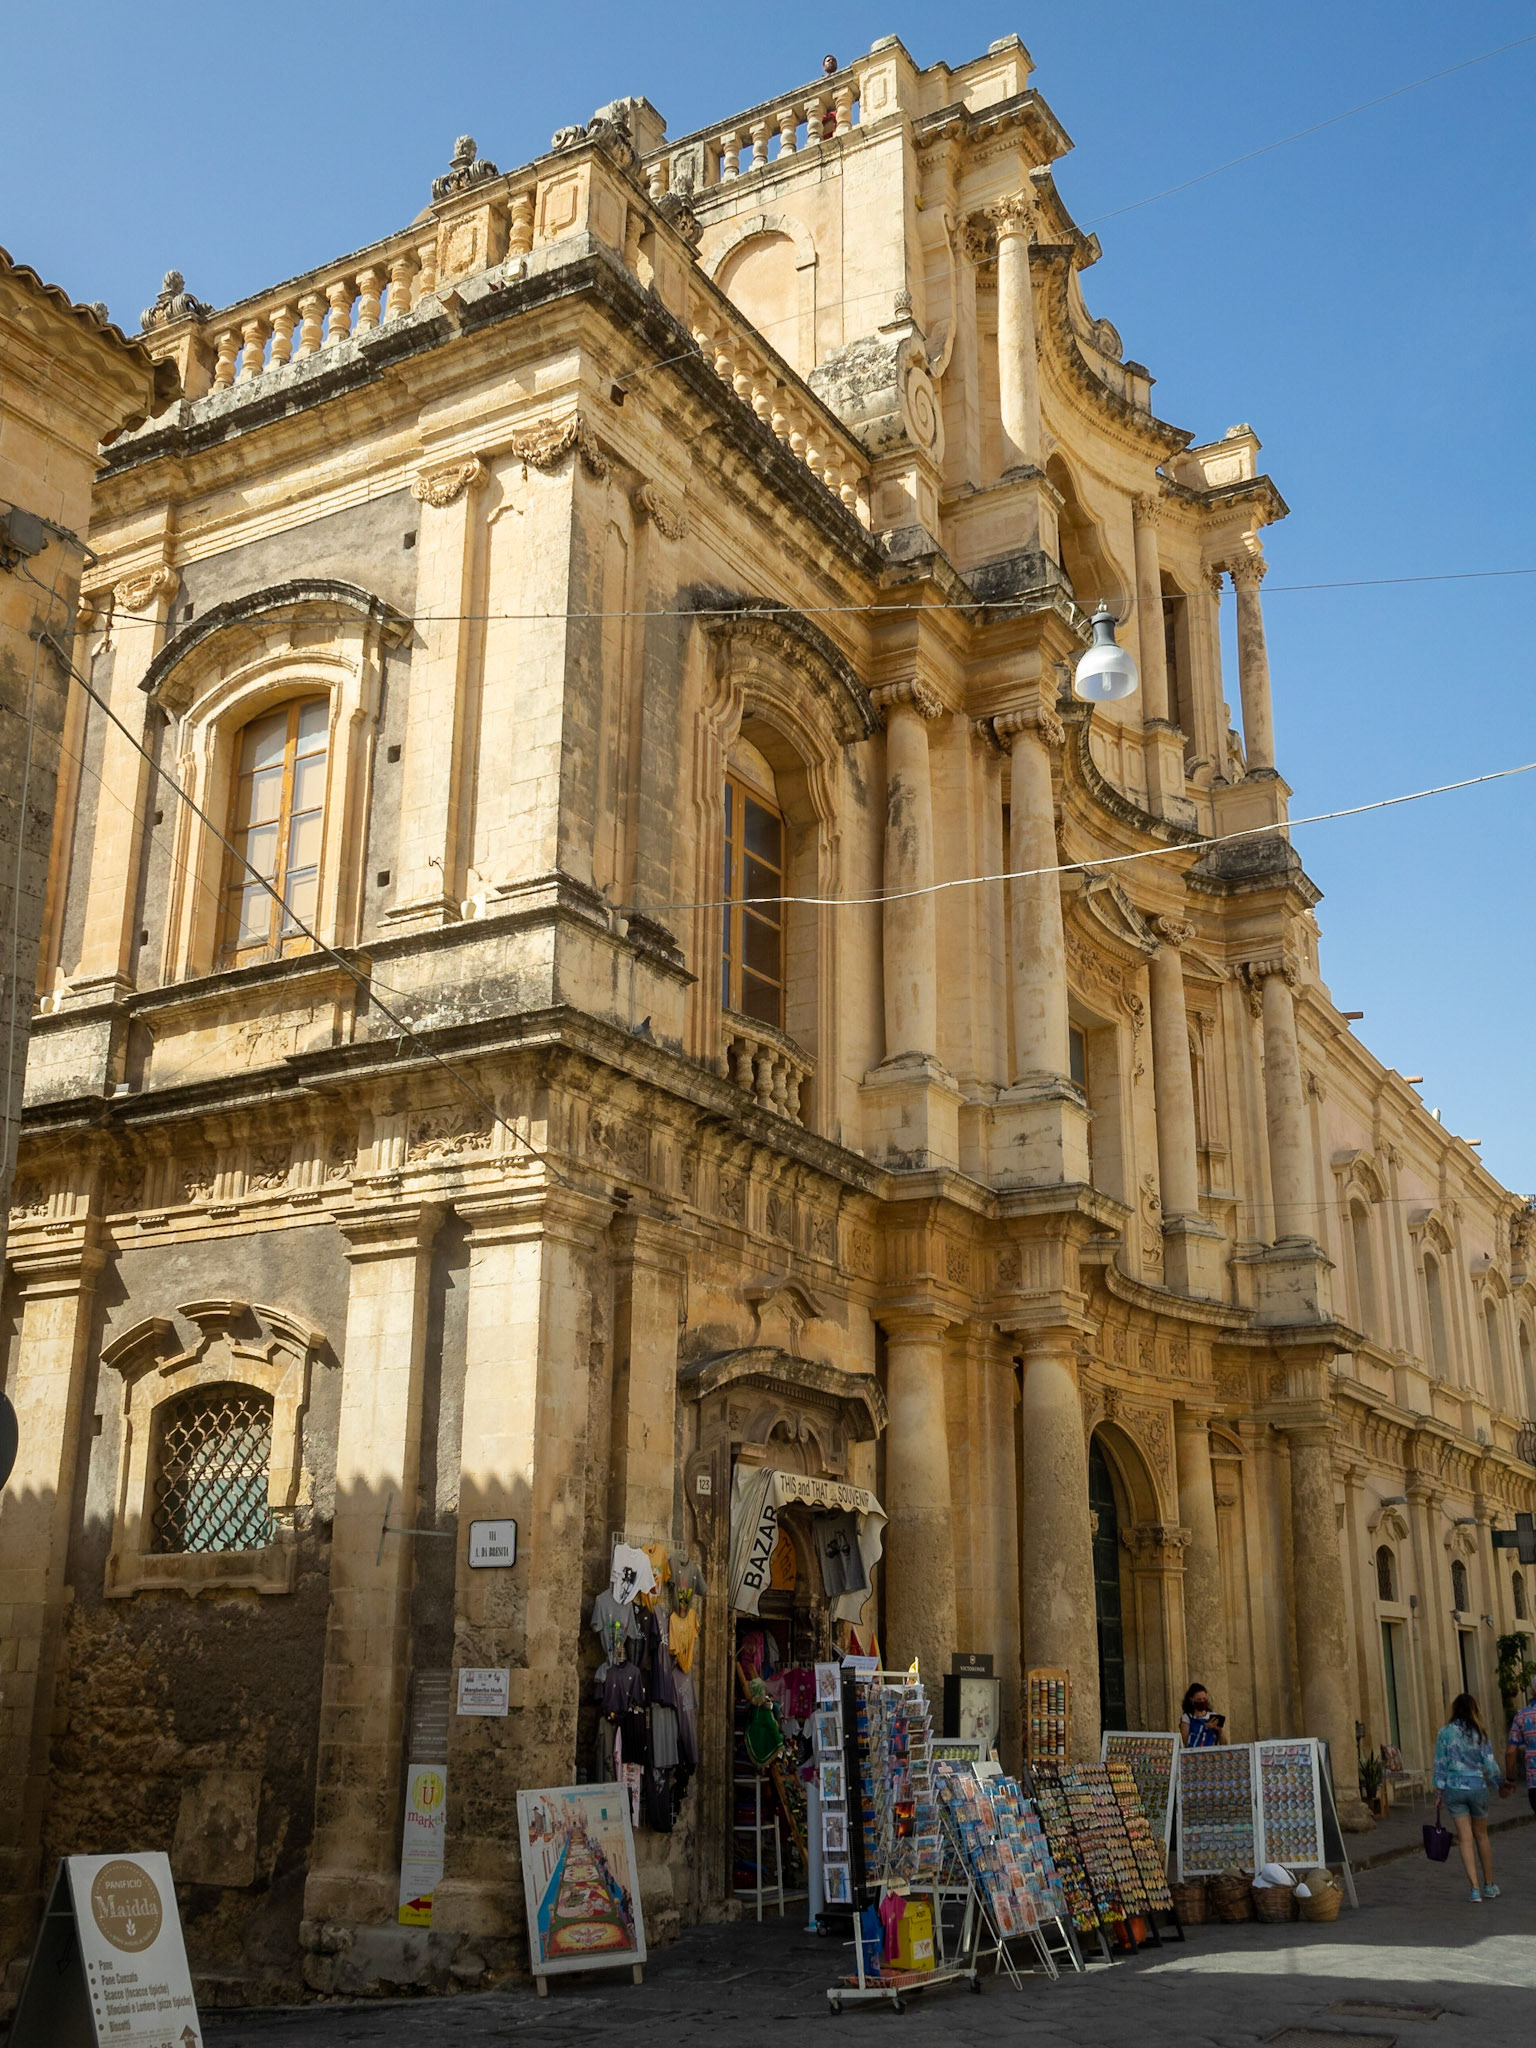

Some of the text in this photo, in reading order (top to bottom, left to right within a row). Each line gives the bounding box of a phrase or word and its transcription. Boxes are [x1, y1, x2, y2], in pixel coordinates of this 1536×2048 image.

[699, 1479, 710, 1490] 123
[780, 1475, 797, 1494] THIS
[798, 1481, 810, 1496] and
[811, 1481, 828, 1500] THAT
[744, 1505, 777, 1589] BAZAR
[407, 1811, 445, 1828] market
[105, 1879, 142, 1889] PANIFICIO
[94, 1895, 159, 1919] Maidda
[99, 1960, 113, 1970] Pane
[101, 1975, 116, 1986] Pane
